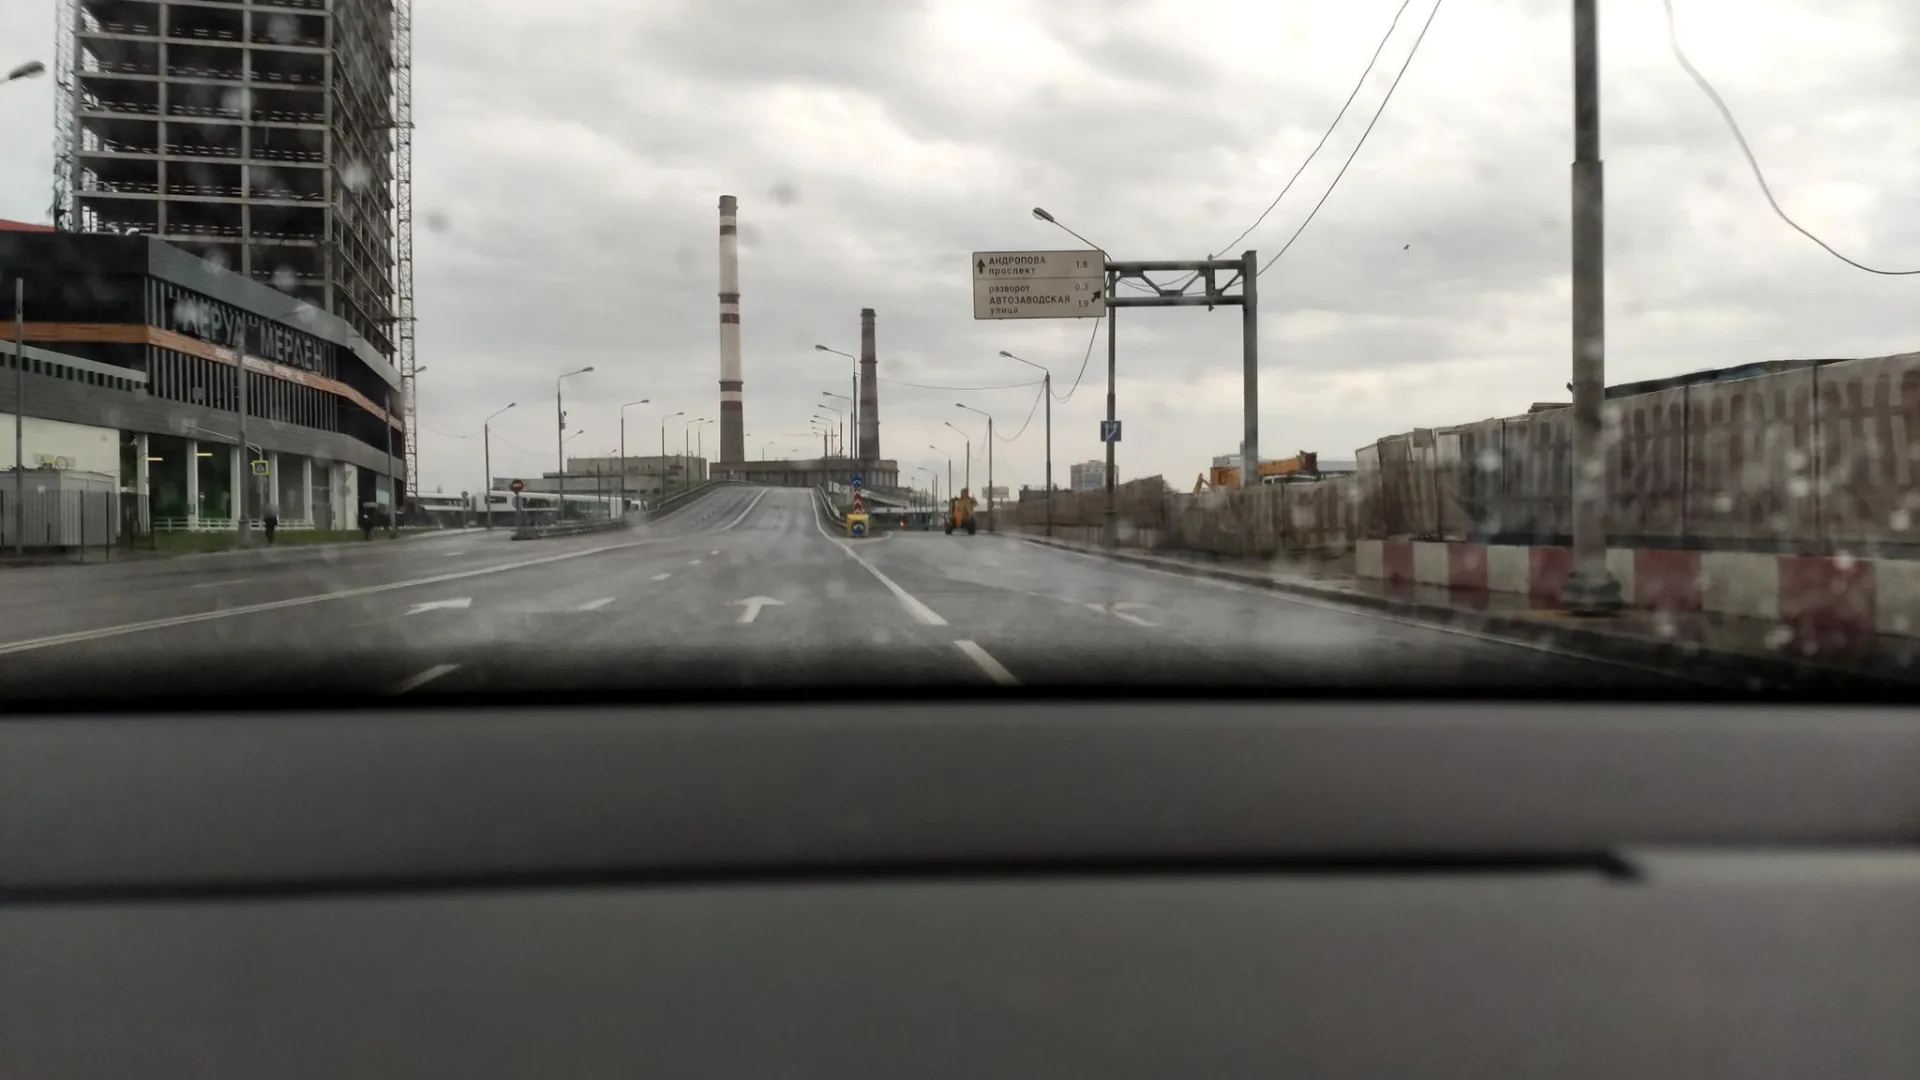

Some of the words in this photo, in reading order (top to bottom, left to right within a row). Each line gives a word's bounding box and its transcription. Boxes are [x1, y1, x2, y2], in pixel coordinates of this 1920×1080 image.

[989, 256, 1046, 266] АНДРОПОВА
[1076, 260, 1088, 269] 1.8
[989, 267, 1036, 276] проспект
[988, 285, 1030, 294] разворот
[989, 295, 1071, 305] АВТОЗАВОДСКАЯ
[989, 307, 1019, 316] улица
[260, 320, 323, 375] МЕРЛЕН
